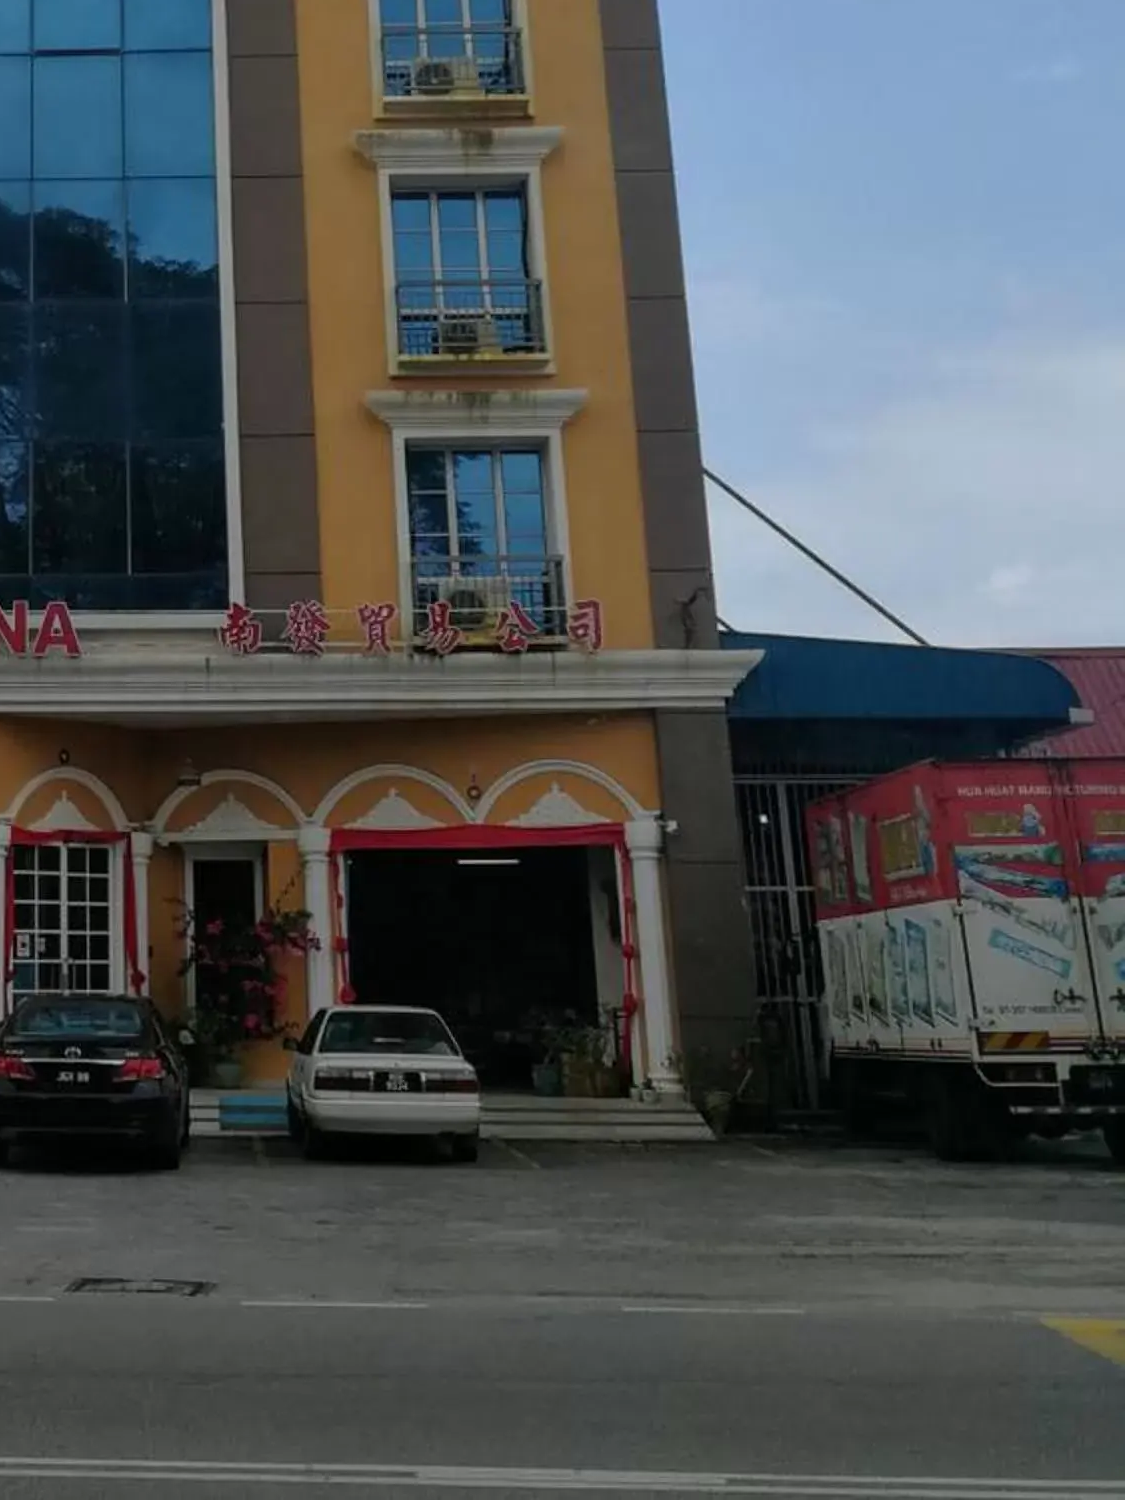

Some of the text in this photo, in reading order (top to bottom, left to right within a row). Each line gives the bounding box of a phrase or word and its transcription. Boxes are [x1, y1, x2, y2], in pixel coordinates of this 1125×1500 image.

[218, 600, 605, 655] 南發貿易公司
